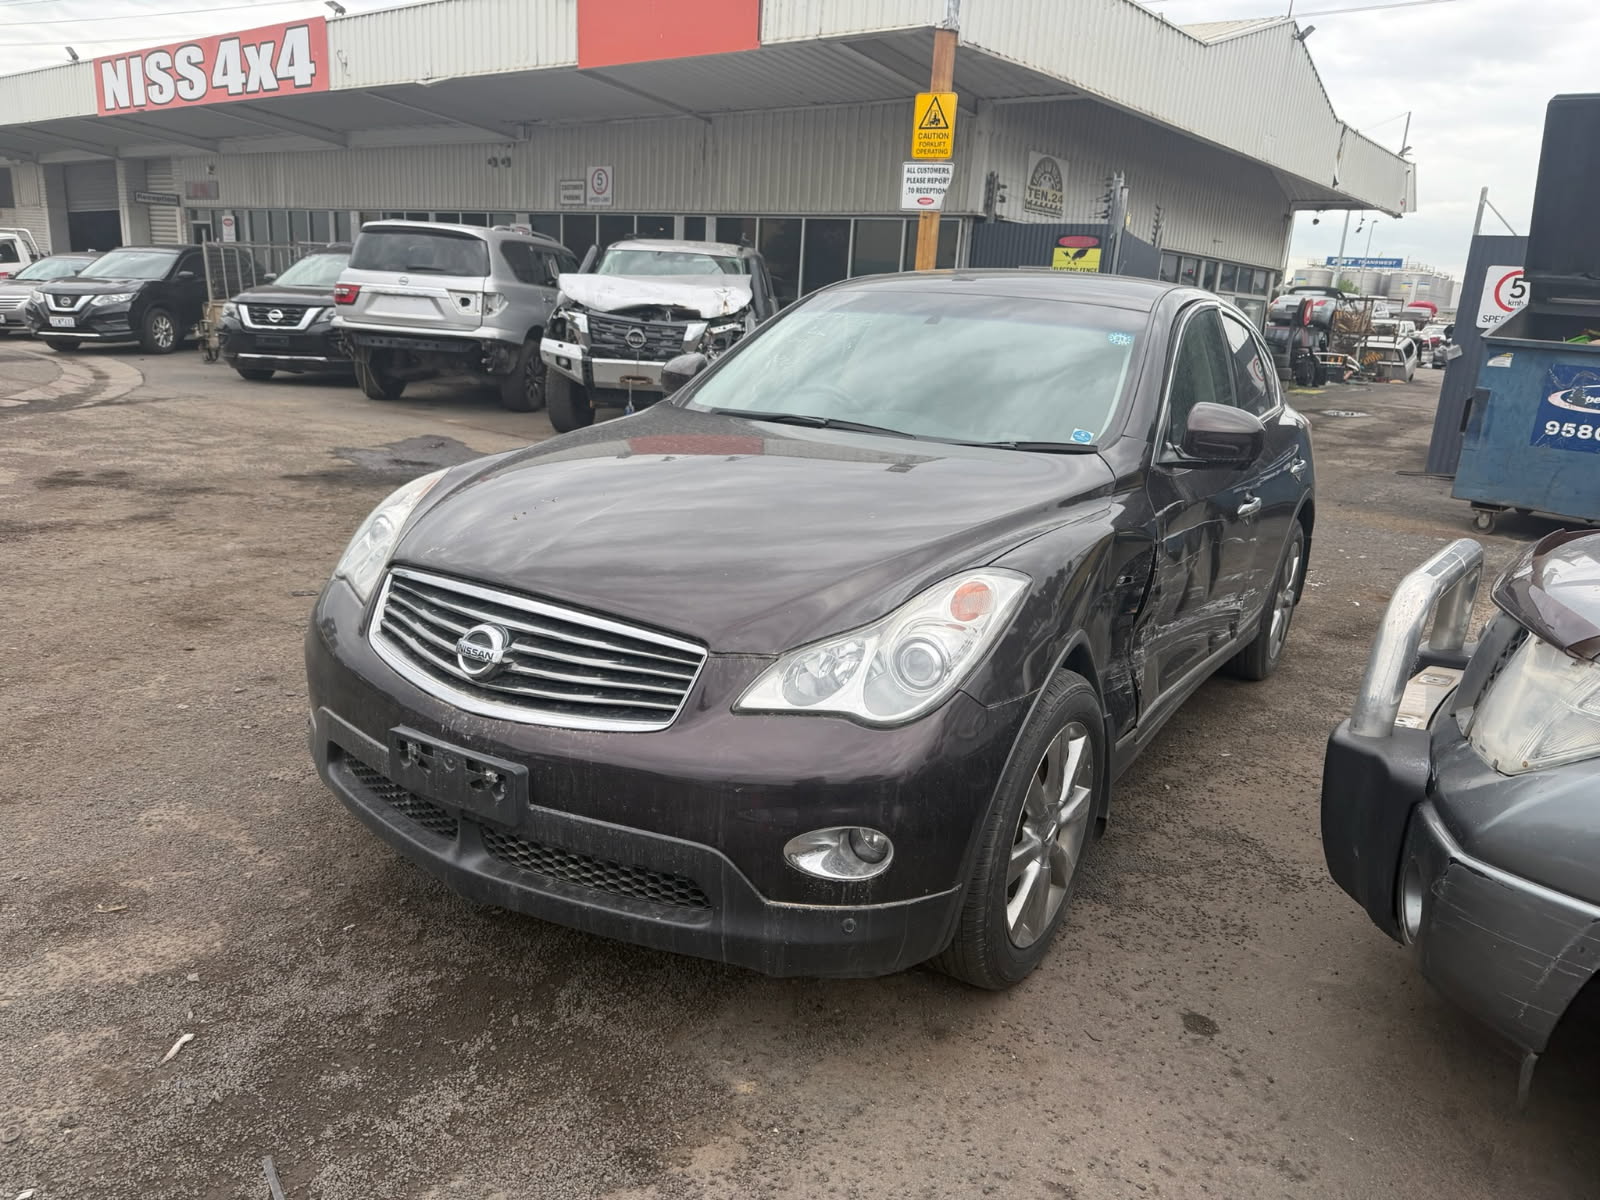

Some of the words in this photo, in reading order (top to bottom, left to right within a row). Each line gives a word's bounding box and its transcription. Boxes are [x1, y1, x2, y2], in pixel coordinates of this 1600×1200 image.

[101, 43, 208, 111] NISS
[211, 24, 316, 95] 4x4
[917, 132, 950, 140] CAUTION
[596, 172, 604, 187] 5
[927, 177, 950, 185] REPORT
[916, 187, 946, 195] RECEPTION
[1509, 277, 1527, 299] 5
[459, 643, 495, 660] NISSAN
